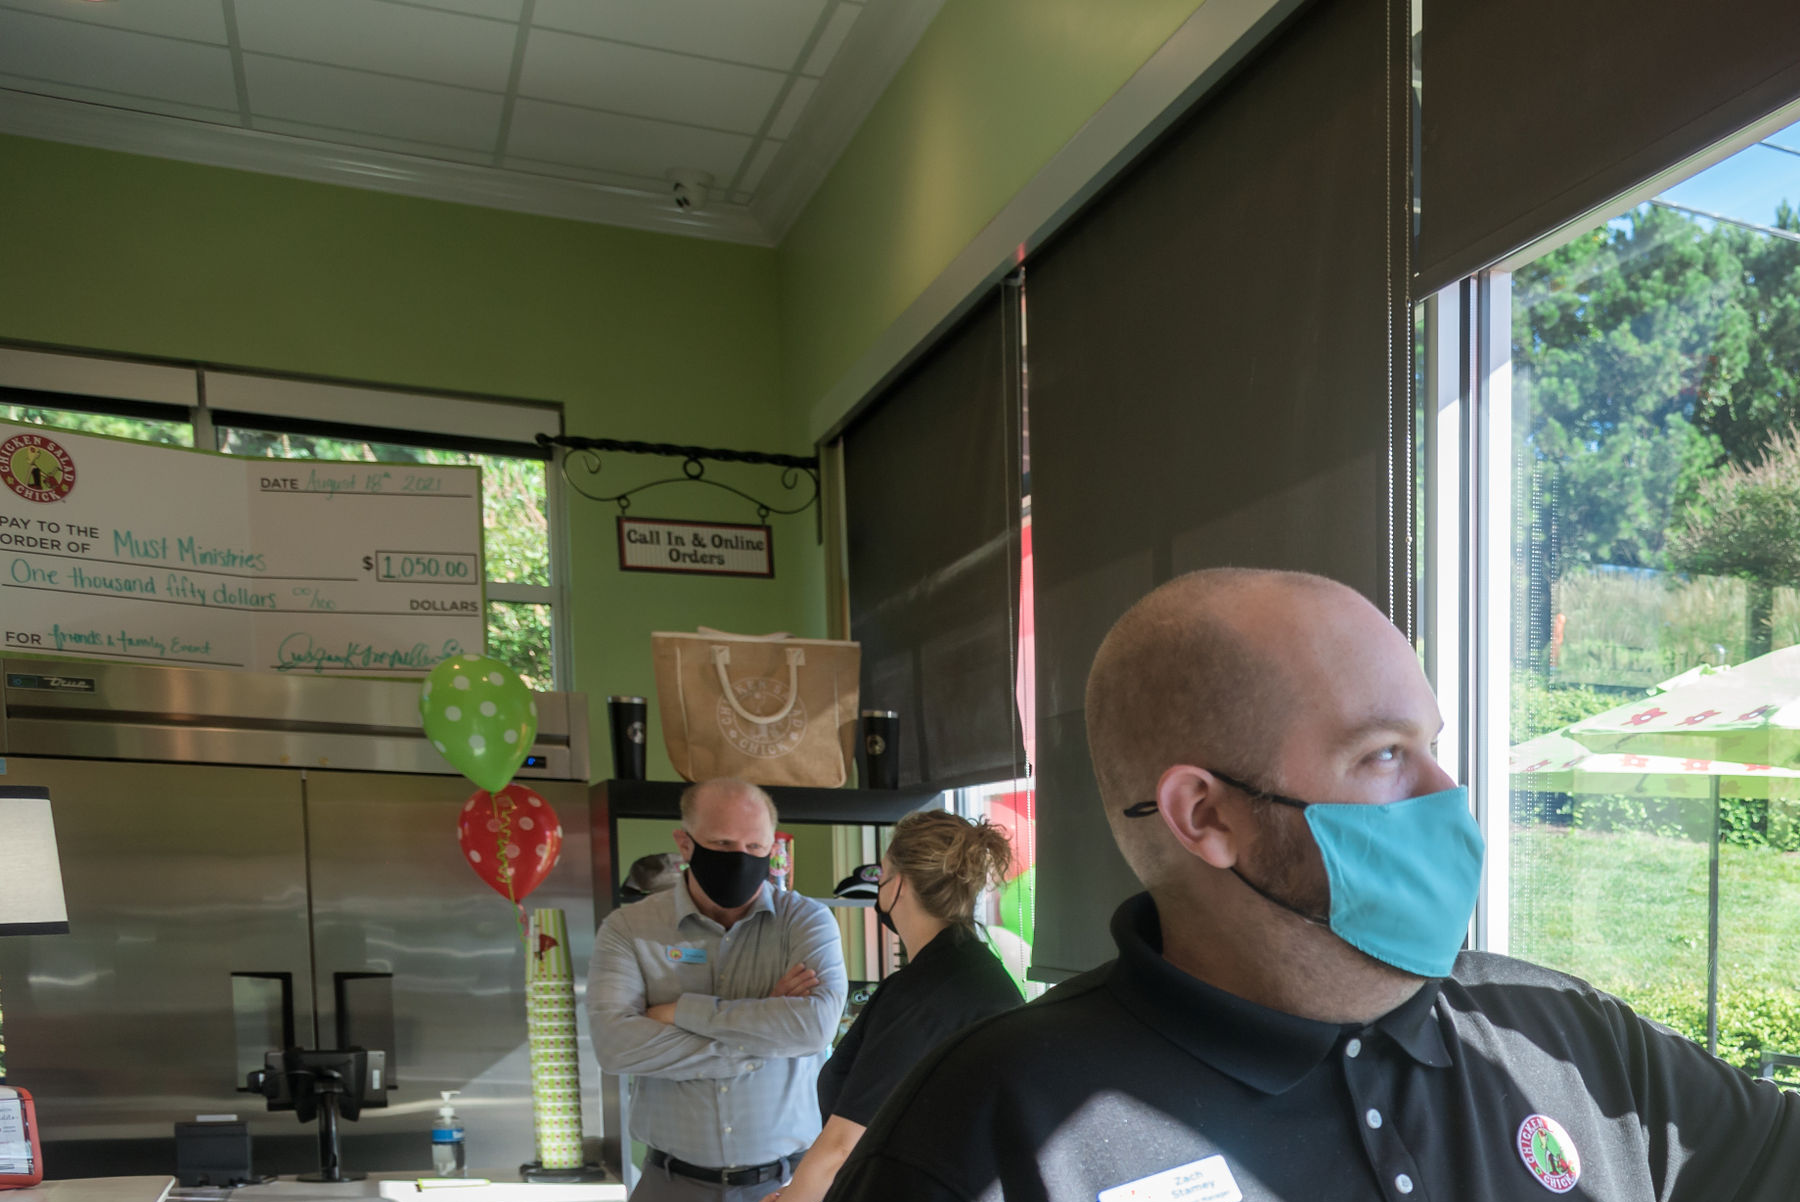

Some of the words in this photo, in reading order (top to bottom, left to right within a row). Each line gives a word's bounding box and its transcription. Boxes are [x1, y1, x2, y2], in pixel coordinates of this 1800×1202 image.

[0, 435, 42, 473] CHICKEN
[47, 442, 75, 482] SALAD
[261, 477, 299, 490] DATE
[15, 485, 61, 502] CHICK
[0, 515, 31, 531] PAY
[36, 519, 61, 534] TO
[66, 524, 100, 539] THE
[0, 533, 62, 552] ORDER
[67, 541, 91, 554] OF
[626, 529, 660, 546] Call
[667, 531, 685, 547] In
[692, 533, 706, 548] &
[711, 534, 765, 551] Online
[113, 529, 168, 560] Must
[177, 535, 267, 572] Ministries
[668, 548, 725, 566] Orders
[362, 555, 374, 571] $
[11, 558, 60, 585] One
[66, 566, 157, 595] thousand
[166, 573, 206, 607] fifty
[213, 582, 278, 609] dollars
[409, 599, 479, 613] DOLLARS
[5, 631, 42, 645] FOR
[1521, 1117, 1545, 1163] CHICKEN
[1174, 1171, 1204, 1186] Zach
[1544, 1173, 1573, 1189] CHICK
